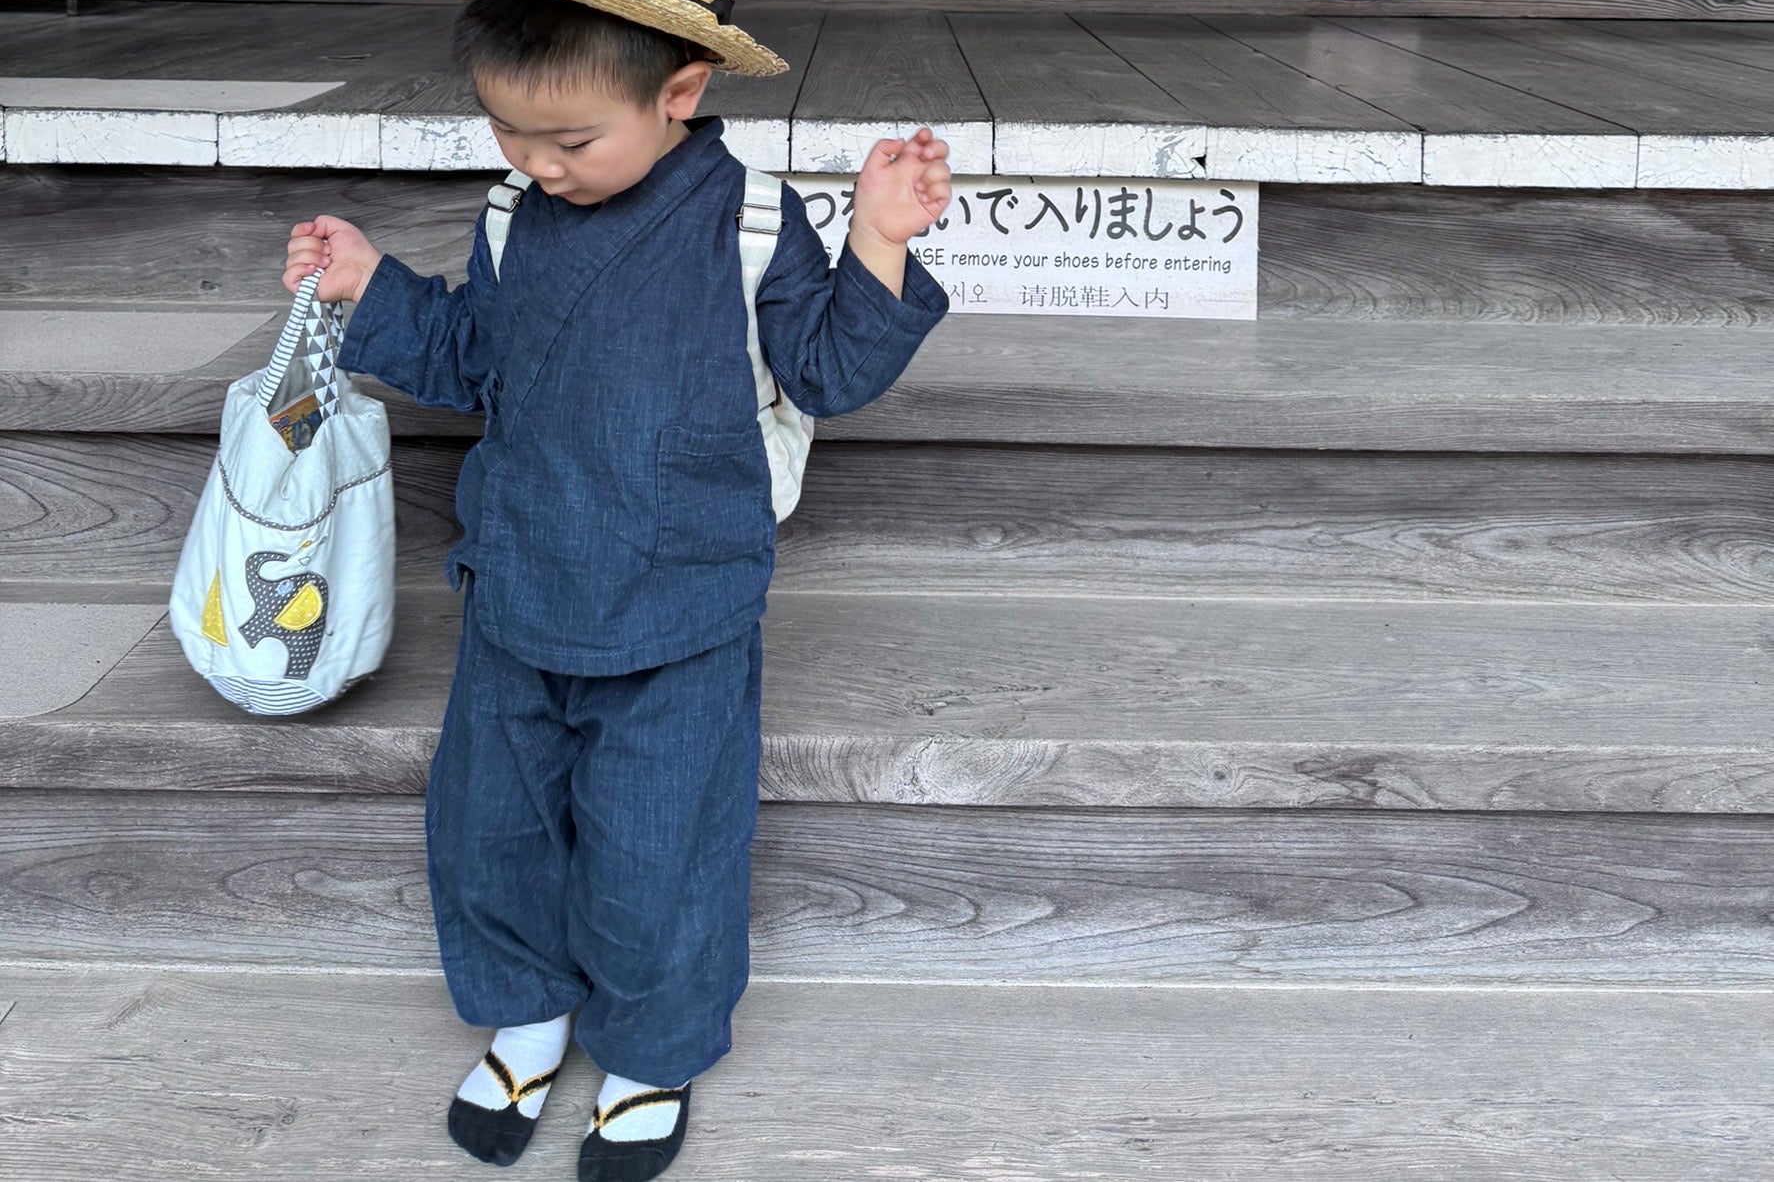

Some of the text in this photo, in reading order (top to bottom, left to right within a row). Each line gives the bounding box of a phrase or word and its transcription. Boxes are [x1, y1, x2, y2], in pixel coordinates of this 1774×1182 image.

[804, 186, 1243, 244] ついで入りましょう
[914, 247, 1232, 274] ASE remove your shoes before entering
[941, 281, 988, 306] 시오
[1019, 284, 1170, 310] 请脱鞋入内
